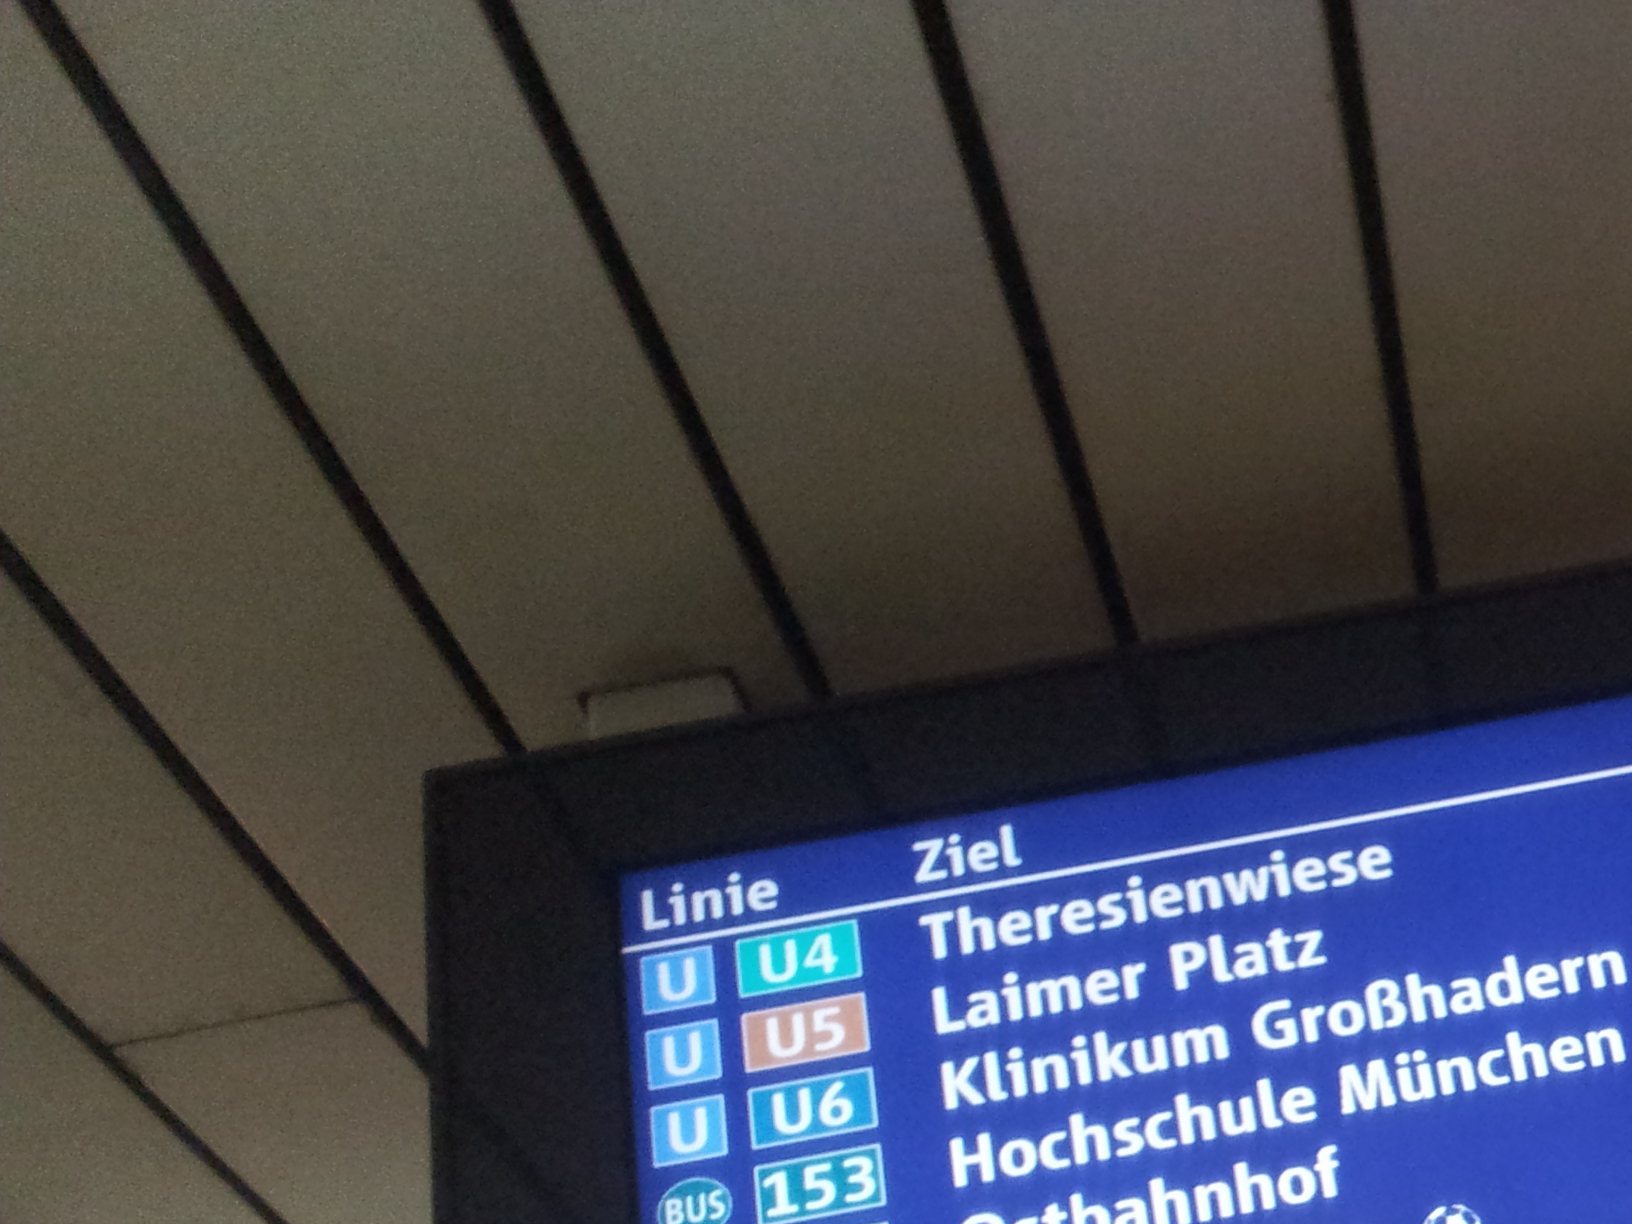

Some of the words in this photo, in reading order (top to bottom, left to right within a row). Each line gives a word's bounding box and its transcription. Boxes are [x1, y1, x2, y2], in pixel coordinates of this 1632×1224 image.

[641, 872, 779, 931] Linie
[912, 825, 1022, 884] Ziel
[657, 957, 697, 1001] U
[758, 933, 838, 983] U4
[918, 844, 1393, 960] Theresienwiese
[662, 1031, 702, 1076] U
[765, 1007, 846, 1058] U5
[931, 961, 1146, 1034] Laimer
[1168, 928, 1327, 991] Platz
[667, 1107, 708, 1153] U
[772, 1081, 853, 1136] U6
[941, 1023, 1229, 1110] Klinikum
[1252, 949, 1628, 1050] Großhadern
[761, 1156, 877, 1218] 153
[949, 1078, 1316, 1187] Hochschule
[1339, 1026, 1627, 1115] München
